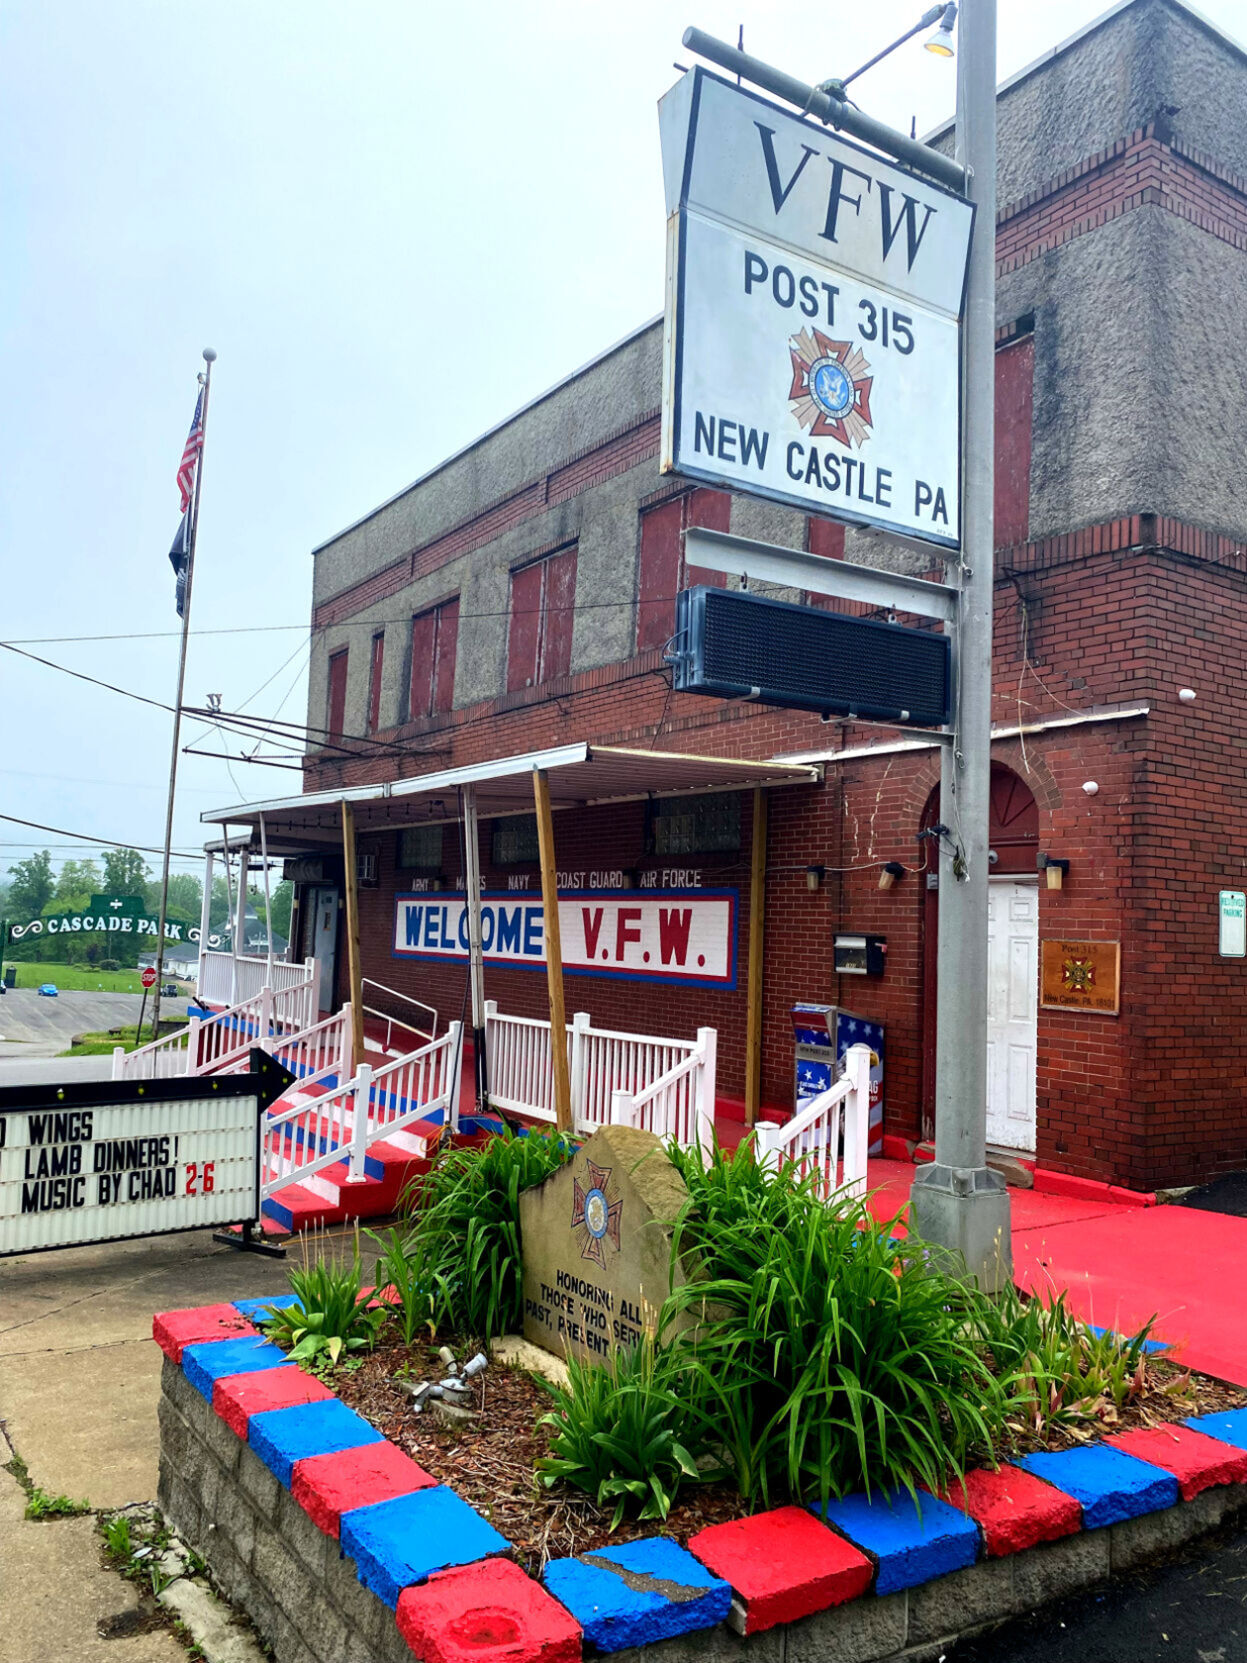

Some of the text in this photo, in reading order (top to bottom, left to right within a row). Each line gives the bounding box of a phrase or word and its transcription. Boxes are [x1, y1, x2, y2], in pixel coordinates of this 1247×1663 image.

[754, 121, 938, 273] VFW
[744, 250, 915, 355] POST 315
[694, 411, 949, 525] NEW CASTLE PA
[508, 875, 530, 890] NAVY
[556, 872, 586, 889] COAST
[589, 870, 623, 889] GUARD
[640, 871, 657, 888] AIR
[662, 869, 702, 888] FORCE
[47, 916, 182, 940] CASCADE PARK
[405, 906, 706, 966] WELCOME V.F.W.
[28, 1112, 93, 1145] WINGS
[25, 1145, 82, 1179] LAMB
[22, 1164, 214, 1213] MUSIC BY CHAD 2-6
[540, 1283, 574, 1315] THOSE
[620, 1300, 642, 1326] ALL
